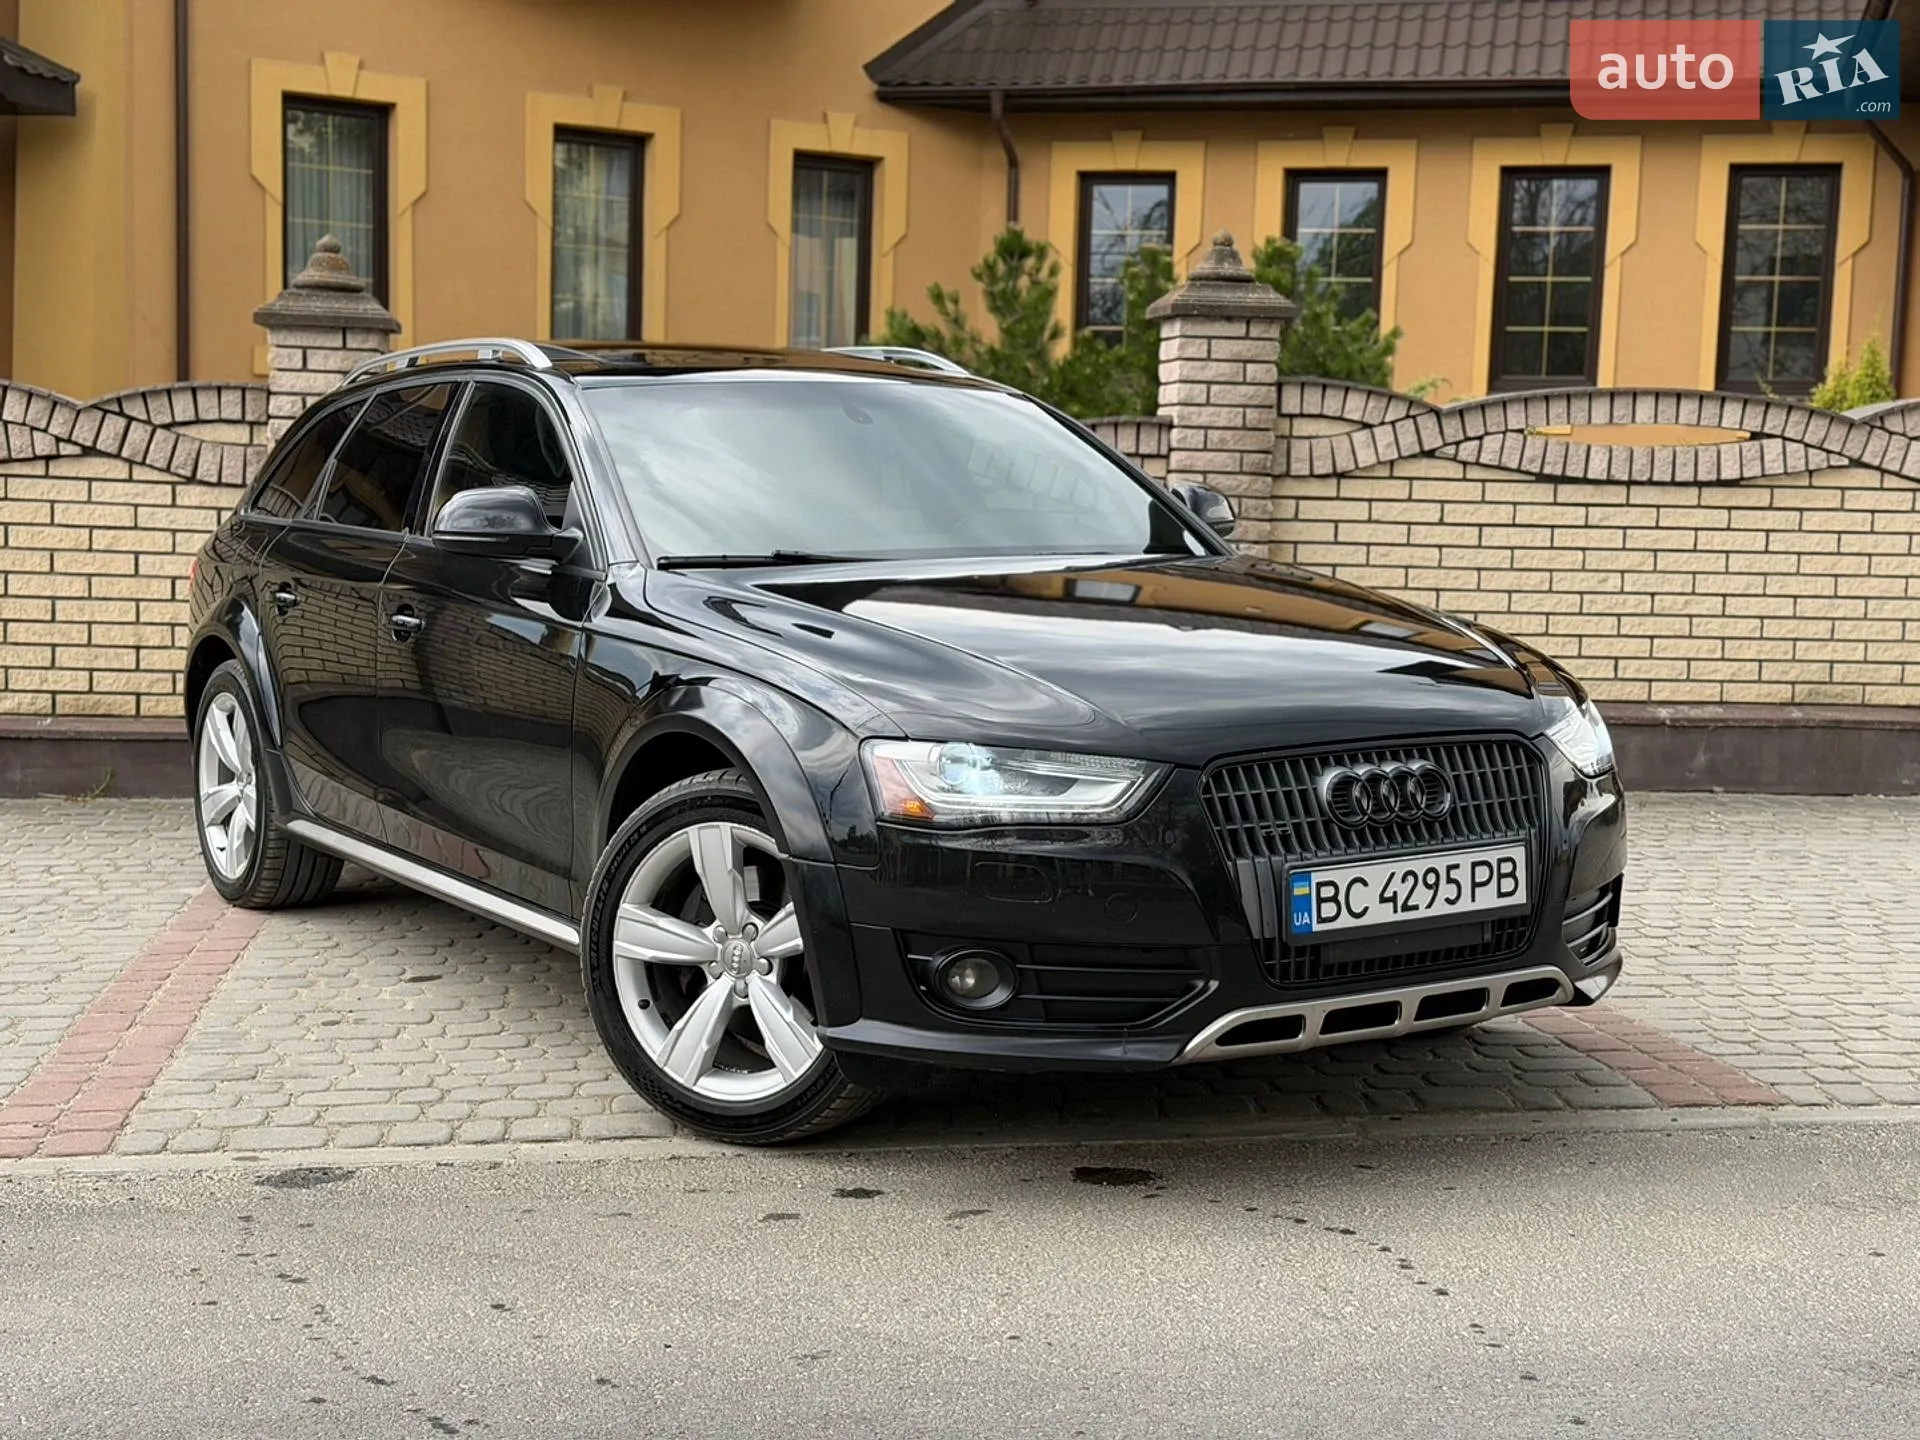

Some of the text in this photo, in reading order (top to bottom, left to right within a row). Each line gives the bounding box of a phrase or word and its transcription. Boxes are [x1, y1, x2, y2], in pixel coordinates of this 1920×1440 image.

[590, 880, 610, 968] MICHELIN
[1293, 911, 1311, 926] UA
[1315, 856, 1519, 924] BC 4295 PB
